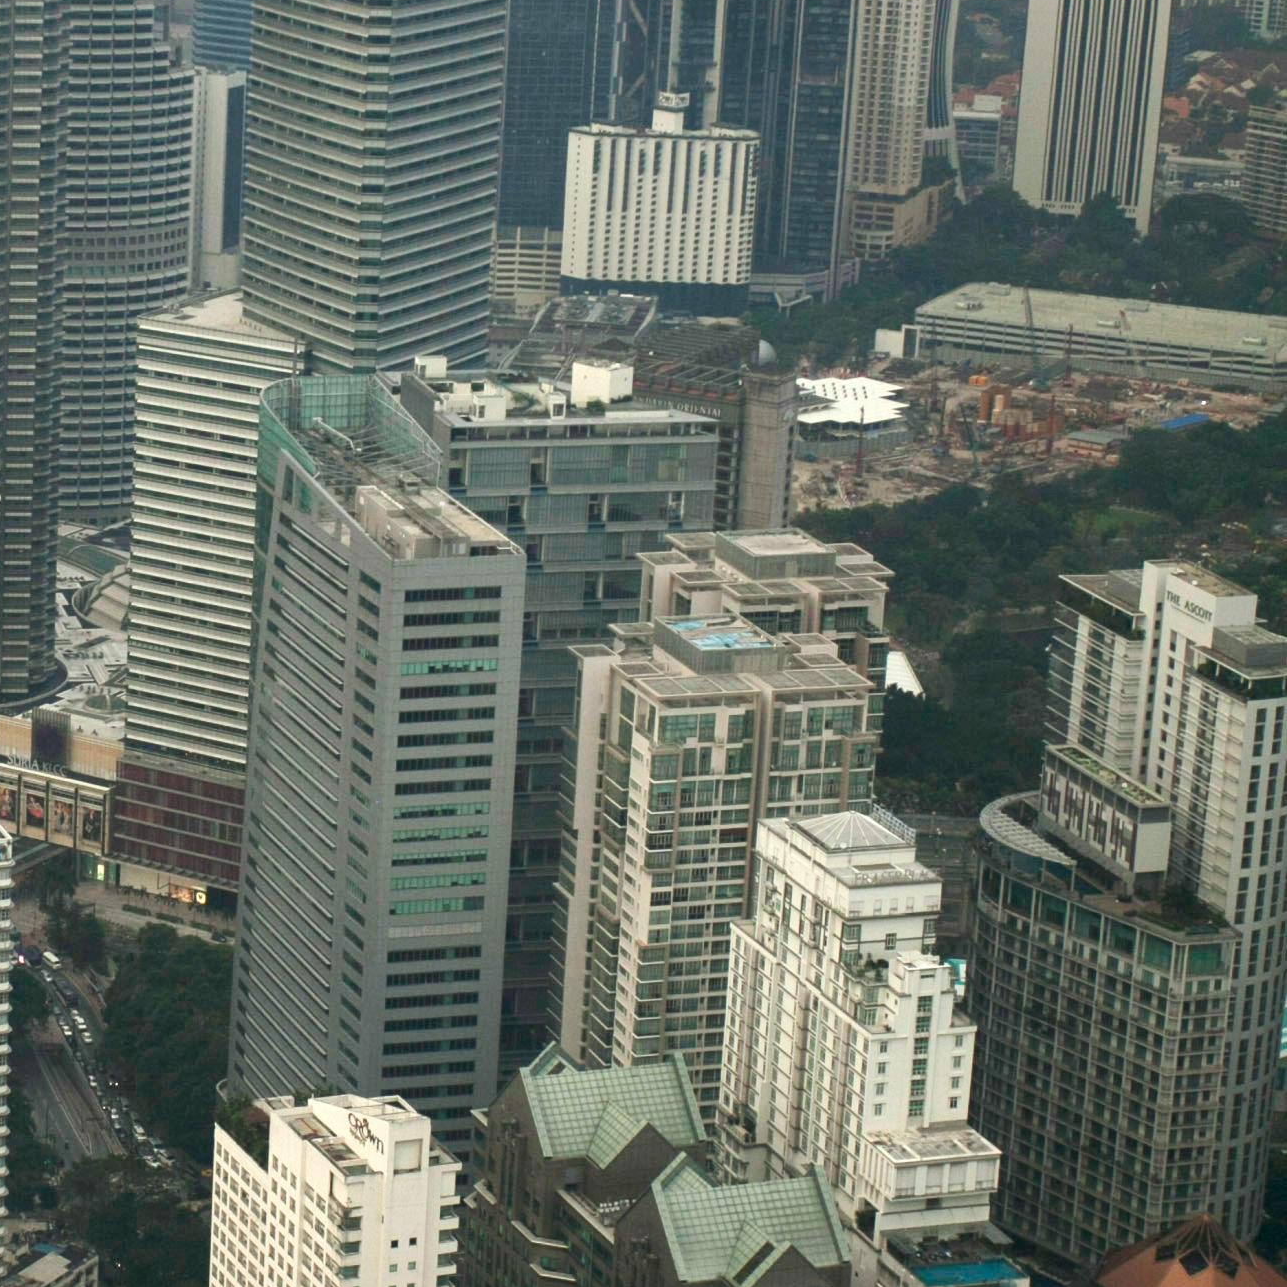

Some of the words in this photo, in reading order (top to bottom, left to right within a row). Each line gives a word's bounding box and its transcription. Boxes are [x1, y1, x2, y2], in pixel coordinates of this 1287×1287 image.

[1167, 590, 1180, 606] THE
[1184, 600, 1213, 622] ASCOTT
[7, 753, 39, 771] SURIA
